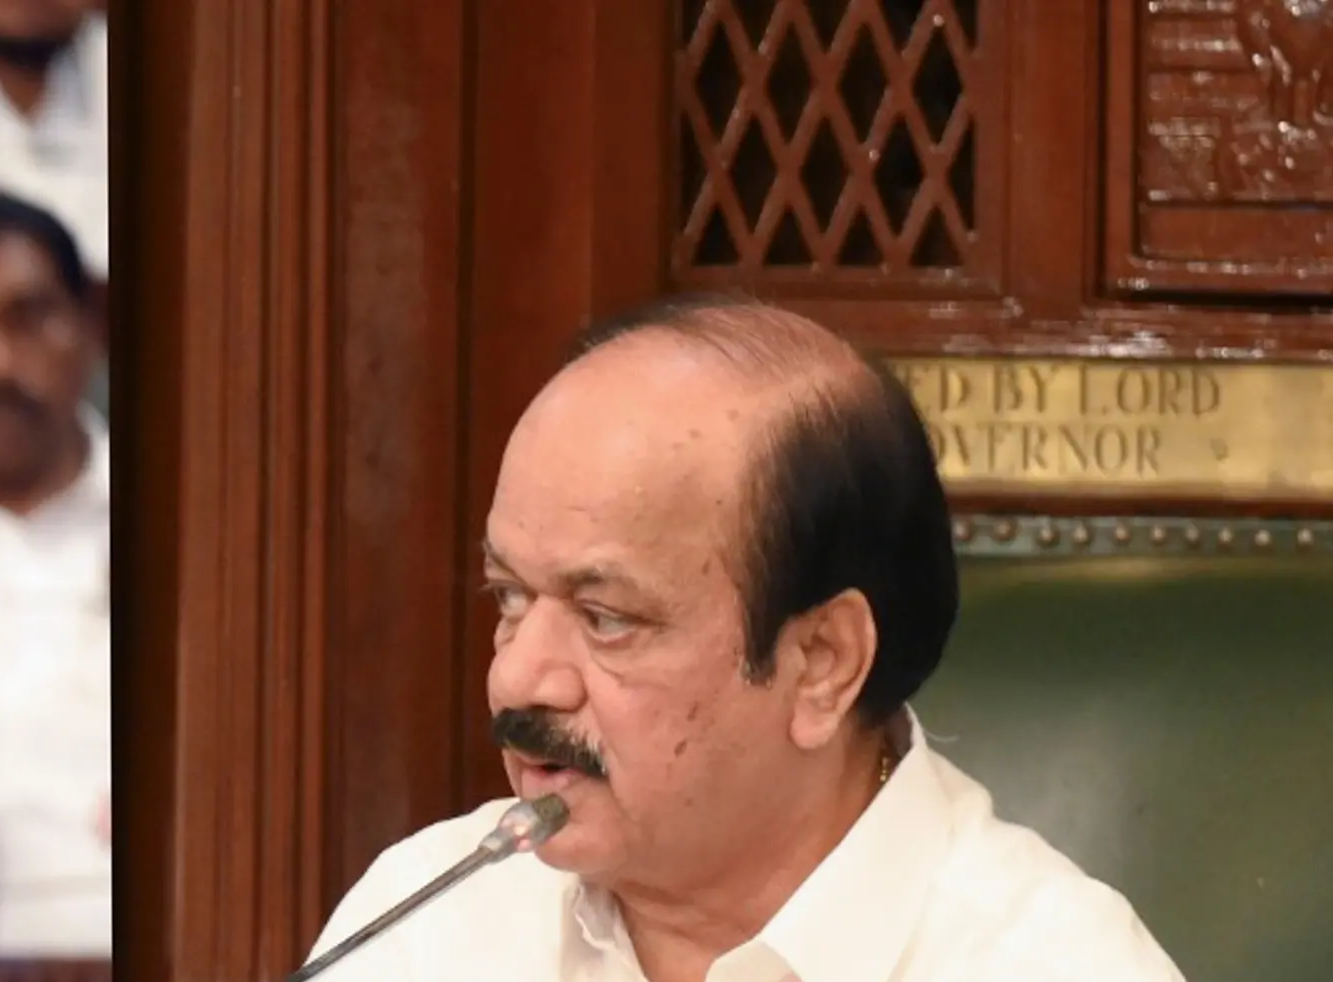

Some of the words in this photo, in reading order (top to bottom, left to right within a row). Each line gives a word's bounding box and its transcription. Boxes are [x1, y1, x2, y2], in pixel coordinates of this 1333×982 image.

[895, 364, 970, 413] ED
[992, 364, 1058, 414] BY
[1078, 365, 1220, 416] LORD
